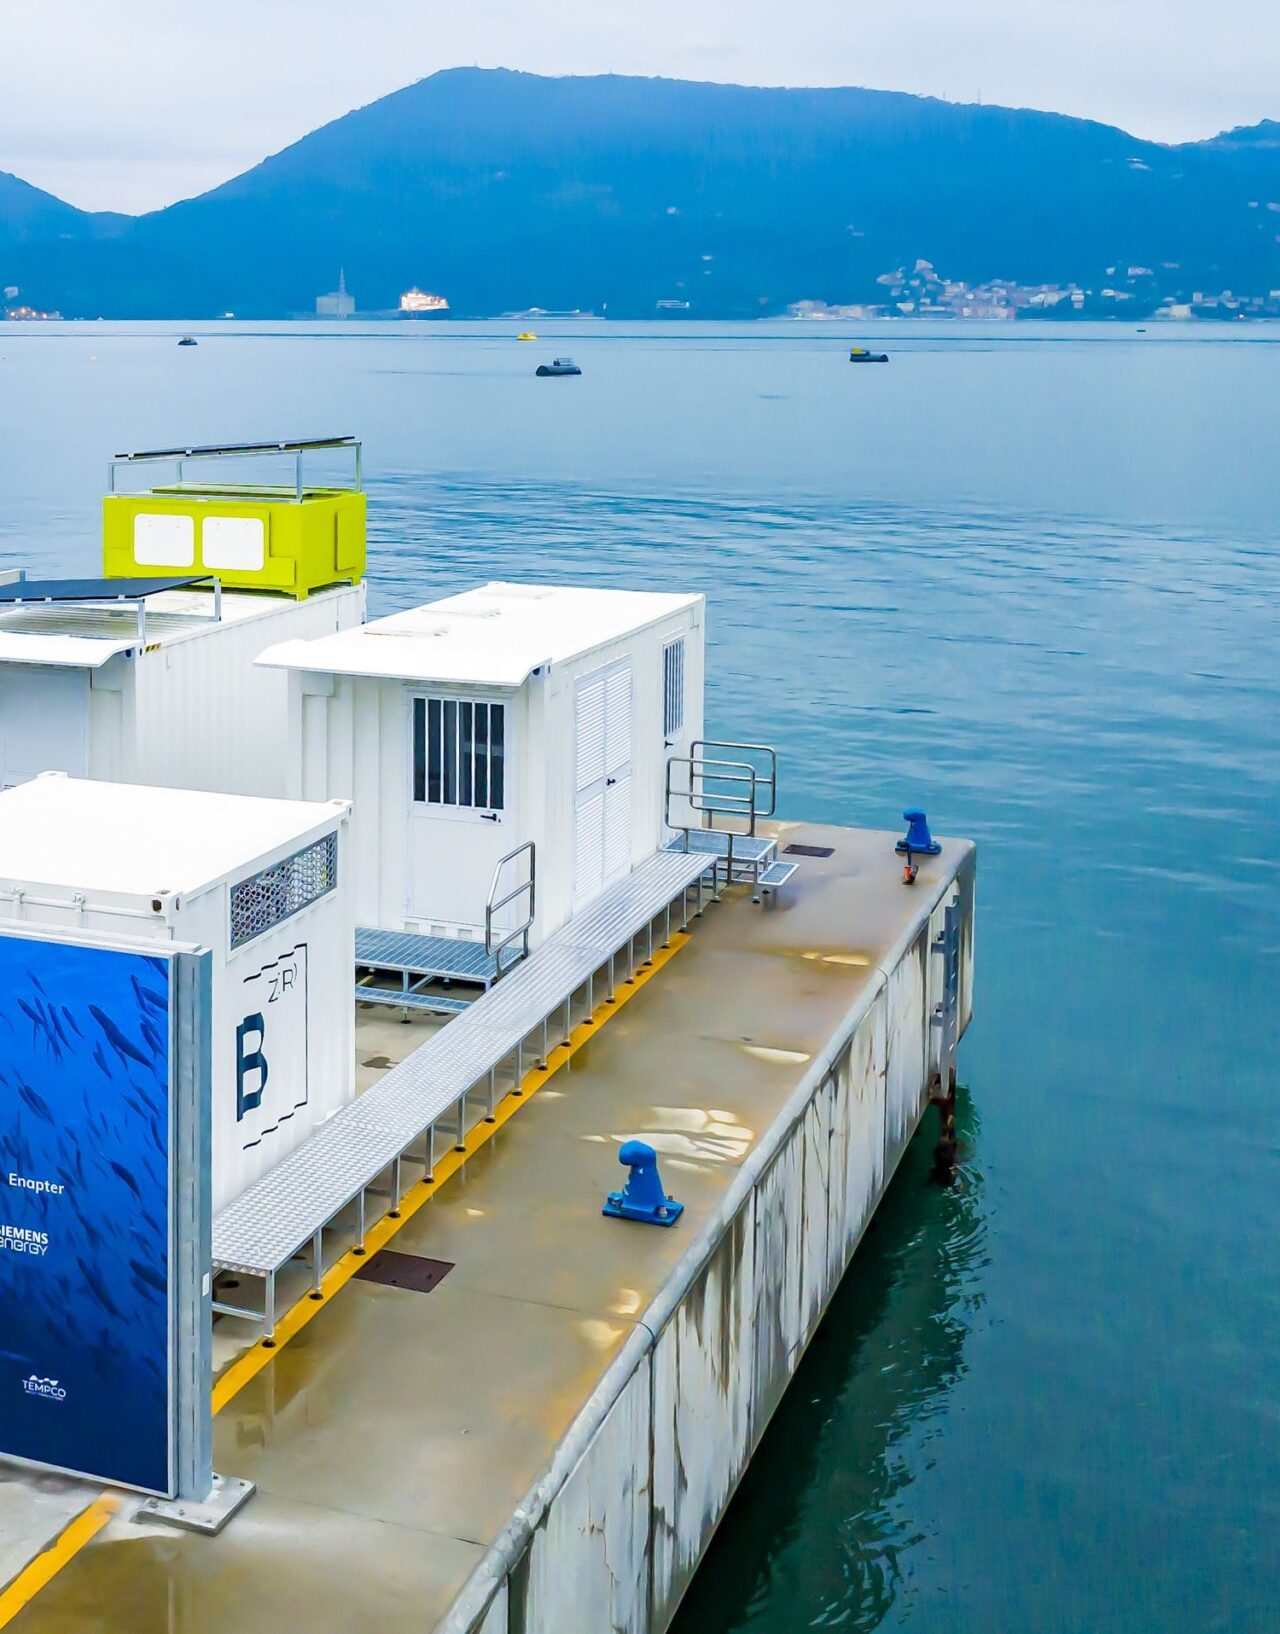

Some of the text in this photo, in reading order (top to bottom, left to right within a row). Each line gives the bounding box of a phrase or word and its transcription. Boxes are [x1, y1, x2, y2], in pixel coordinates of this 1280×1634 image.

[236, 1012, 269, 1122] B
[9, 1173, 65, 1194] Enapter
[22, 1379, 67, 1398] TEMPCO
